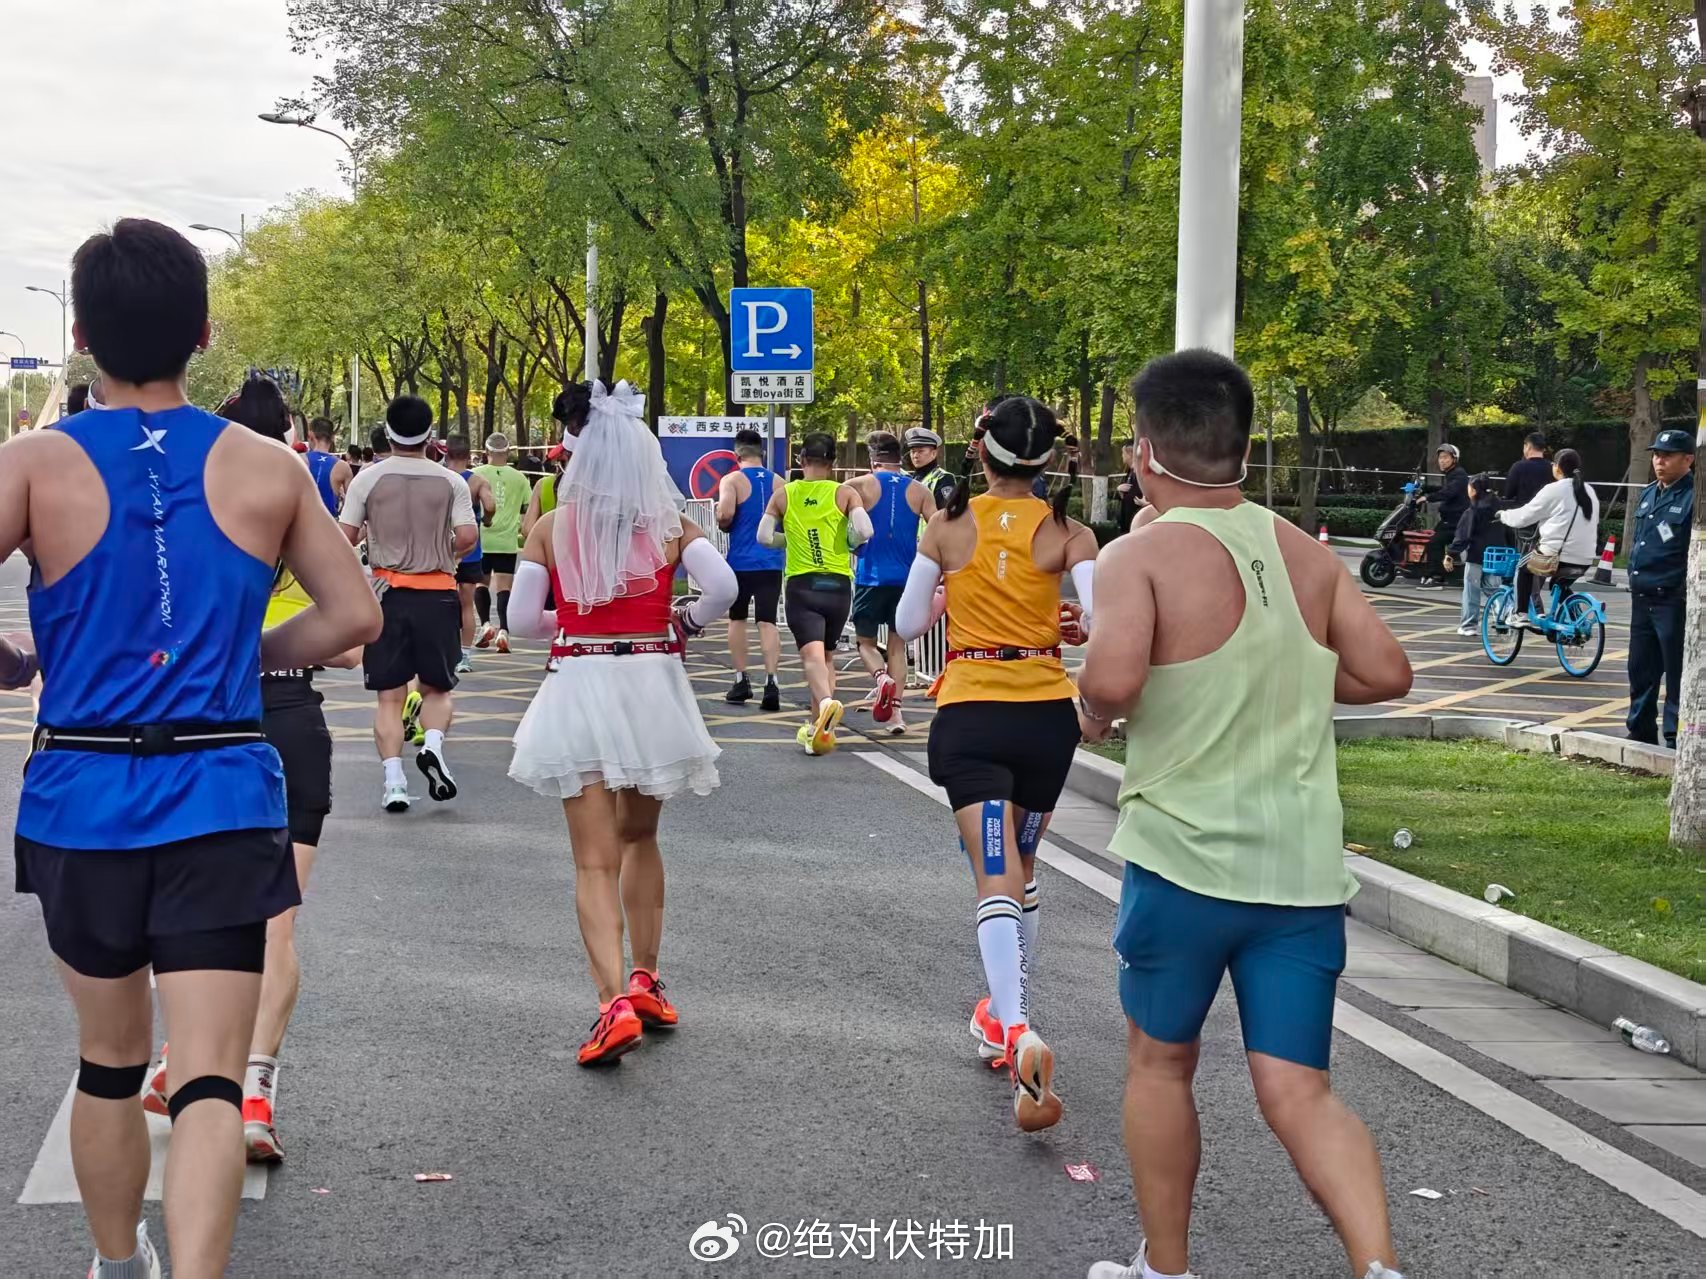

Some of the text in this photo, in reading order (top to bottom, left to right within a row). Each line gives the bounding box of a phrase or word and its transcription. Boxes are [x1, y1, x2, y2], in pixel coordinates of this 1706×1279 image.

[741, 301, 788, 358] P
[741, 376, 804, 387] 凯悦酒店
[741, 388, 805, 399] 源创oya街区
[154, 524, 172, 628] MARATHON
[986, 817, 994, 857] MARATHON
[1020, 976, 1029, 1018] SPIRIT
